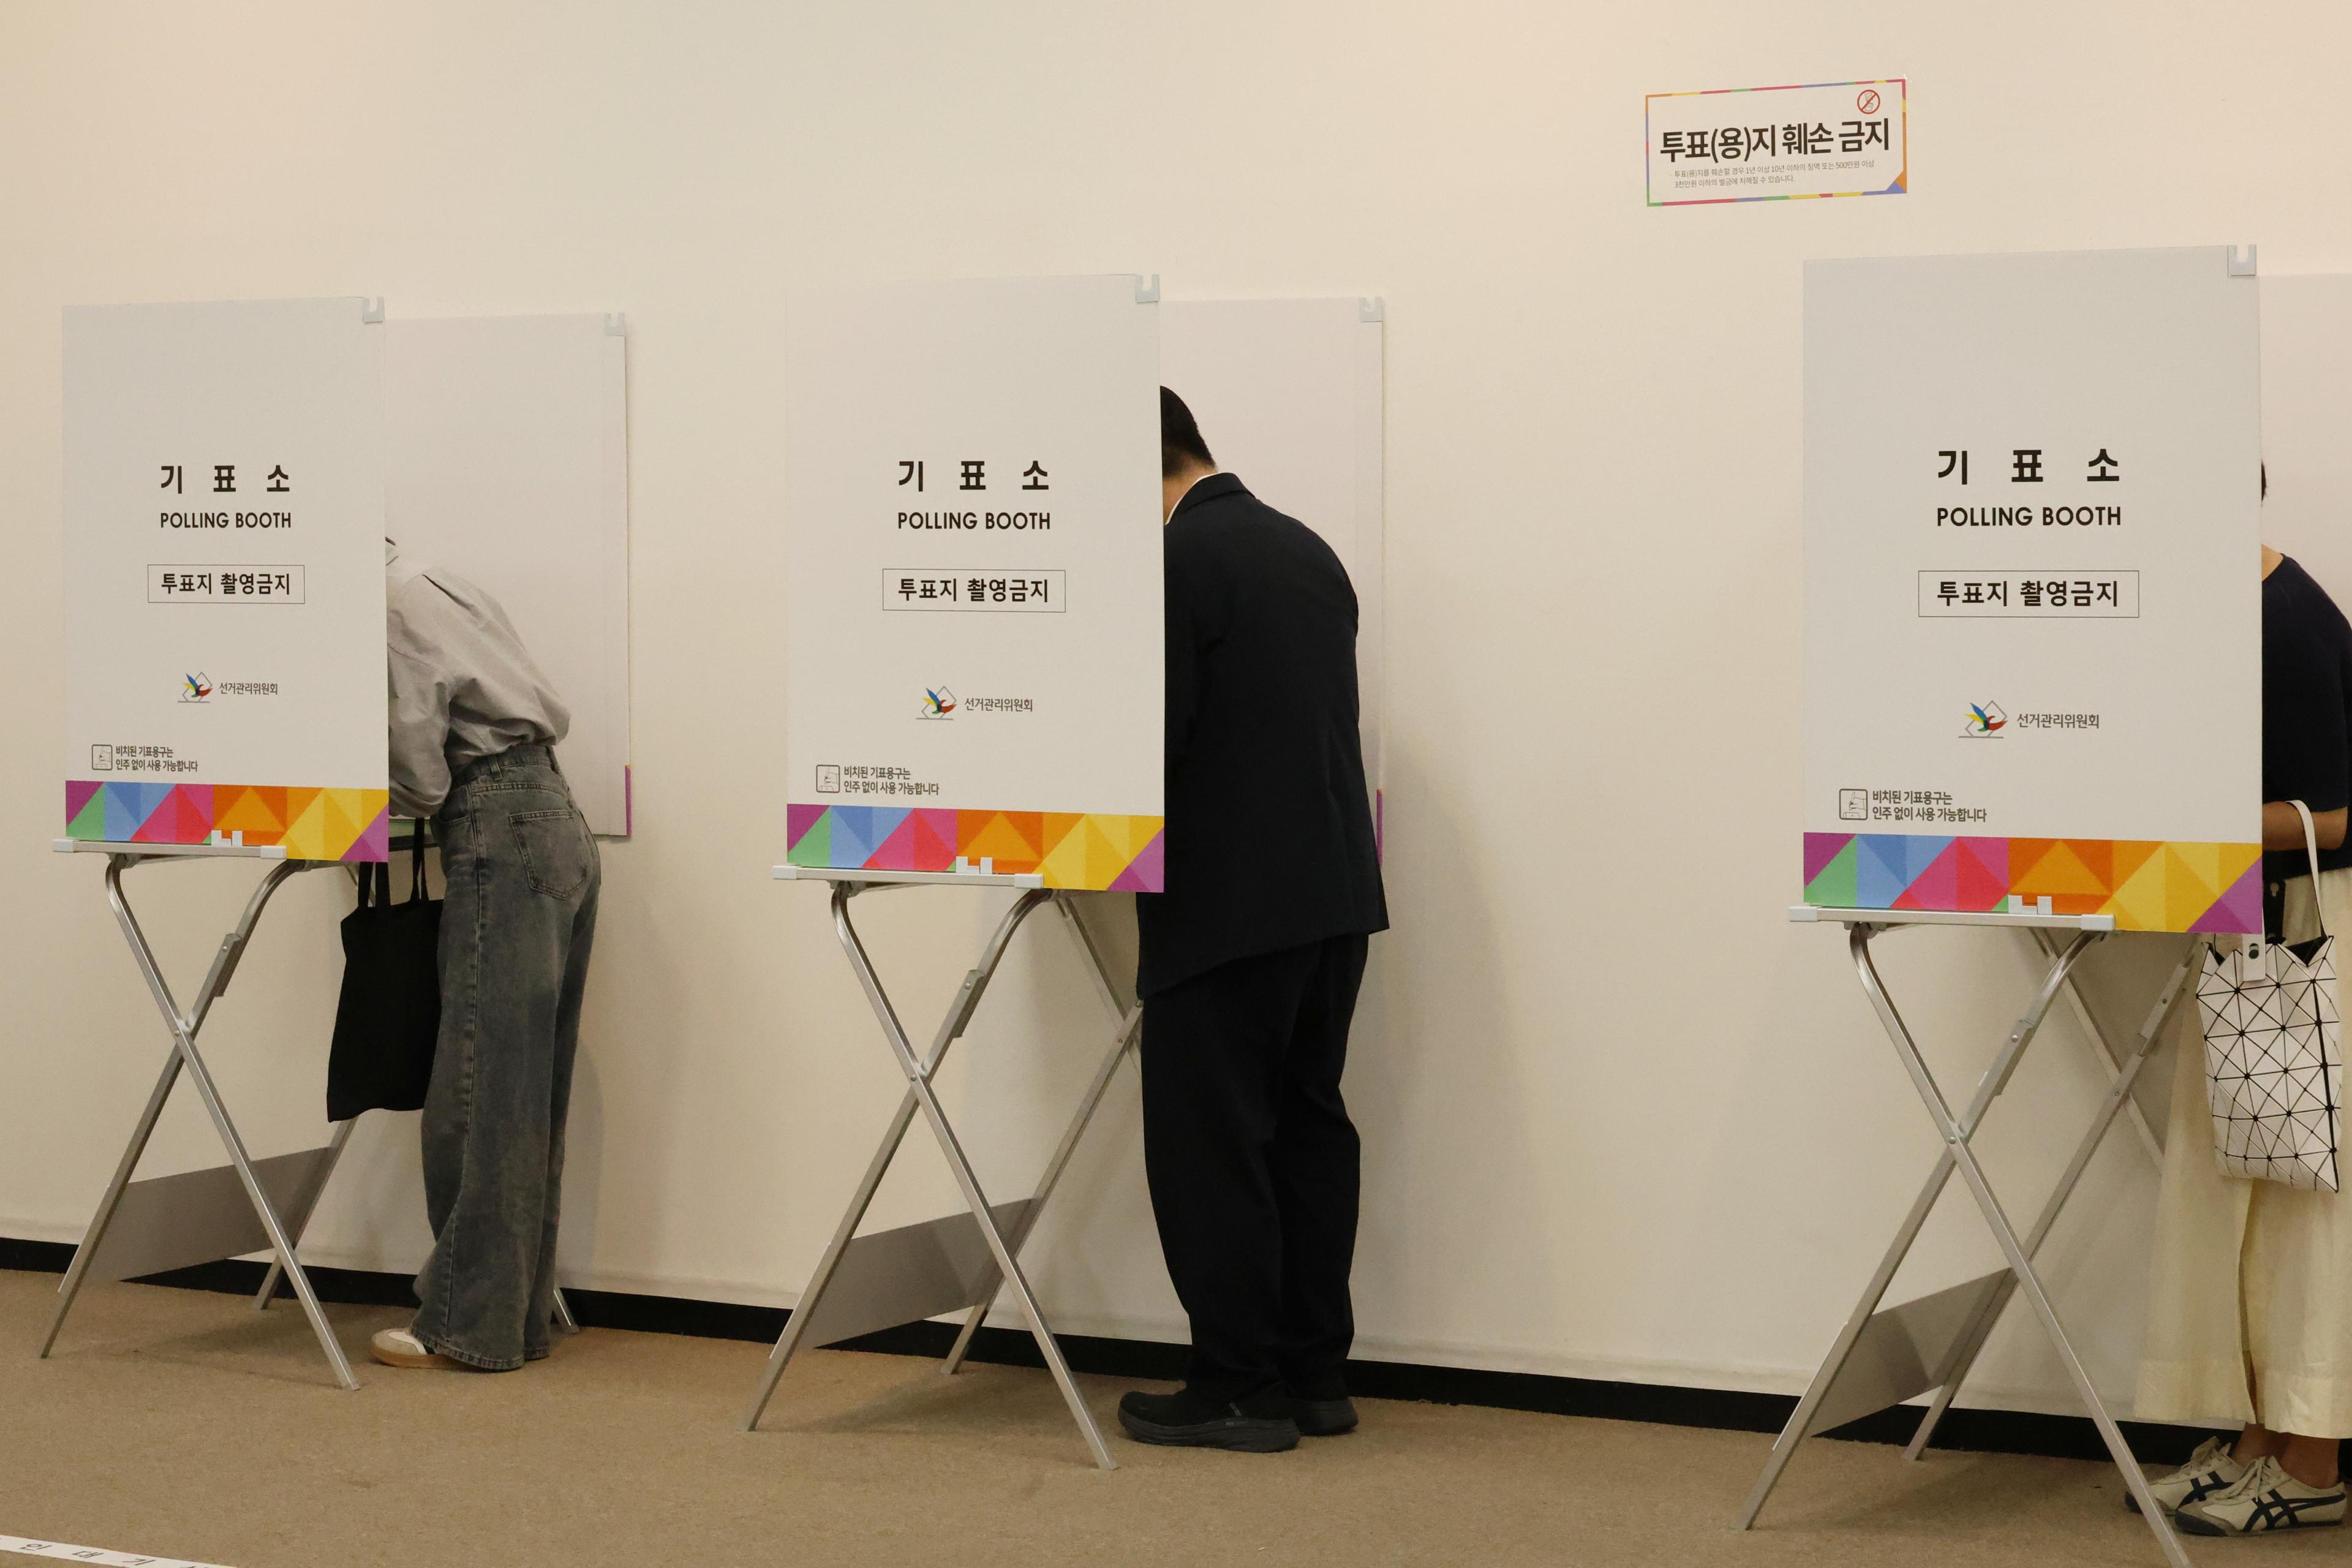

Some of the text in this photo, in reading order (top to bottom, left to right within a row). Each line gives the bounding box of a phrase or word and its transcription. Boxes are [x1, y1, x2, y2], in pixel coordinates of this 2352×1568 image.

[1660, 118, 1889, 164] 투표(용)지 훼손 금지
[1675, 168, 1709, 178] 투표(용)지를
[1711, 168, 1731, 176] 훼손할
[1732, 167, 1745, 175] 경우
[1757, 165, 1770, 174] 이상
[1771, 164, 1785, 173] 10년
[1787, 164, 1806, 172] 이하의
[1807, 162, 1820, 171] 징역
[1822, 162, 1834, 170] 또는
[1836, 160, 1860, 169] 500만원
[1861, 159, 1875, 168] 이상
[1674, 179, 1697, 189] 3천만원
[1698, 179, 1718, 187] 이하의
[1719, 178, 1738, 186] 벌금에
[1740, 176, 1759, 185] 처해질
[1768, 175, 1796, 184] 있습니다.
[161, 512, 291, 529] POLLING BOOTH
[898, 511, 1050, 529] POLLING BOOTH
[1937, 507, 2121, 527] POLLING BOOTH
[161, 573, 290, 595] 투표지 촬영금지
[898, 578, 1048, 603] 투표지 촬영금지
[1937, 581, 2117, 608] 투표지 촬영금지
[219, 682, 278, 695] 선거관리위원회
[965, 698, 1033, 712] 선거관리위원회
[2017, 713, 2100, 729] 선거관리위원회
[116, 745, 173, 758] 비치된 기표용구는
[116, 759, 198, 772] 인주 없이 사용 가능합니다
[844, 766, 911, 780] 비치된 기표용구는
[844, 780, 940, 796] 인주 없이 사용 가능합니다
[1872, 790, 1953, 805] 비치된 기표용구는
[1872, 806, 1987, 823] 인주 없이 사용 가능합니다
